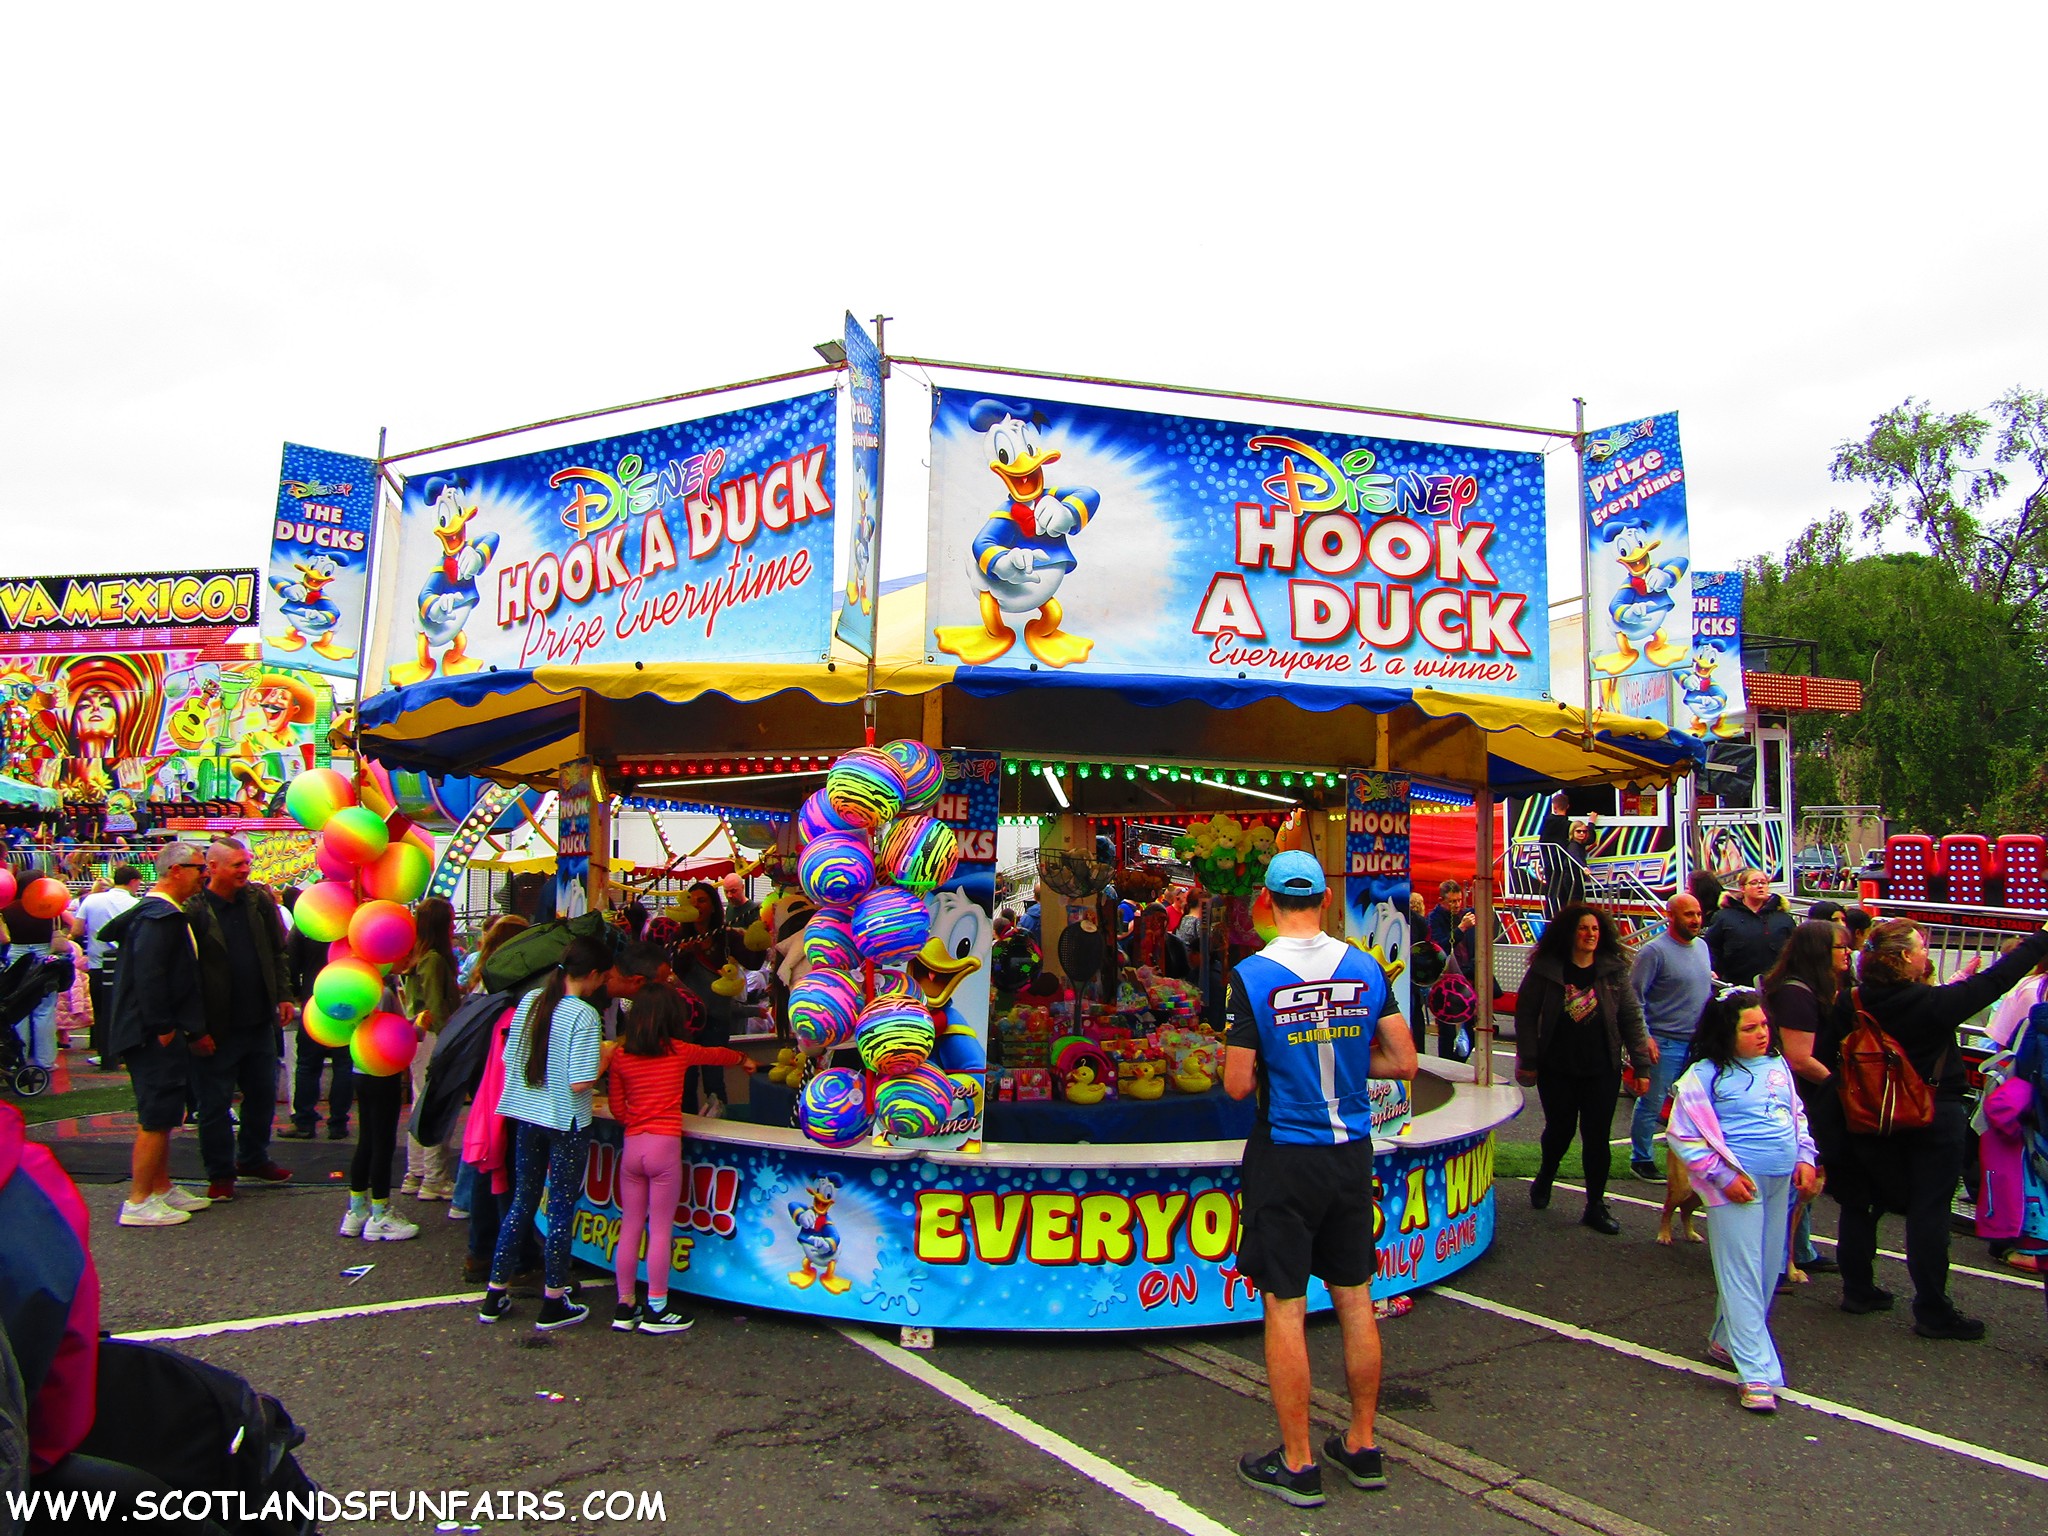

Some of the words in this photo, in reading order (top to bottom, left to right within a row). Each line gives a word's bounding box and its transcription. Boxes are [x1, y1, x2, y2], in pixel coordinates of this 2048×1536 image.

[1587, 449, 1664, 503] Prize
[303, 502, 342, 524] THE
[1590, 468, 1684, 527] Everytime
[275, 519, 365, 552] DUCKS
[497, 525, 629, 628] HOOK
[639, 510, 676, 584] A
[687, 443, 834, 559] DUCK
[1235, 502, 1499, 585] HOOK
[61, 575, 253, 626] MEXICO!
[519, 608, 606, 668] Prize
[616, 546, 812, 638] Everytime
[1192, 572, 1266, 639] A
[1288, 579, 1532, 655] DUCK
[1692, 617, 1736, 636] UCKS
[1208, 632, 1377, 680] Everyone's
[1385, 657, 1406, 675] a
[1413, 654, 1518, 682] winner
[560, 795, 589, 818] HOOK
[927, 794, 969, 820] HE
[1349, 811, 1408, 835] HOOK
[560, 832, 587, 853] DUCK
[1373, 834, 1385, 851] A
[1351, 852, 1406, 876] DUCK
[1905, 910, 1952, 924] ENTRANCE
[1962, 915, 1997, 928] PLEASE
[2000, 920, 2032, 931] STAND
[1269, 979, 1369, 1012] GT
[1274, 1006, 1369, 1026] Bicycles
[1287, 1025, 1361, 1046] SHIMANO
[1399, 1165, 1430, 1234] A
[1434, 1212, 1478, 1262] GAME
[1138, 1264, 1198, 1310] ON
